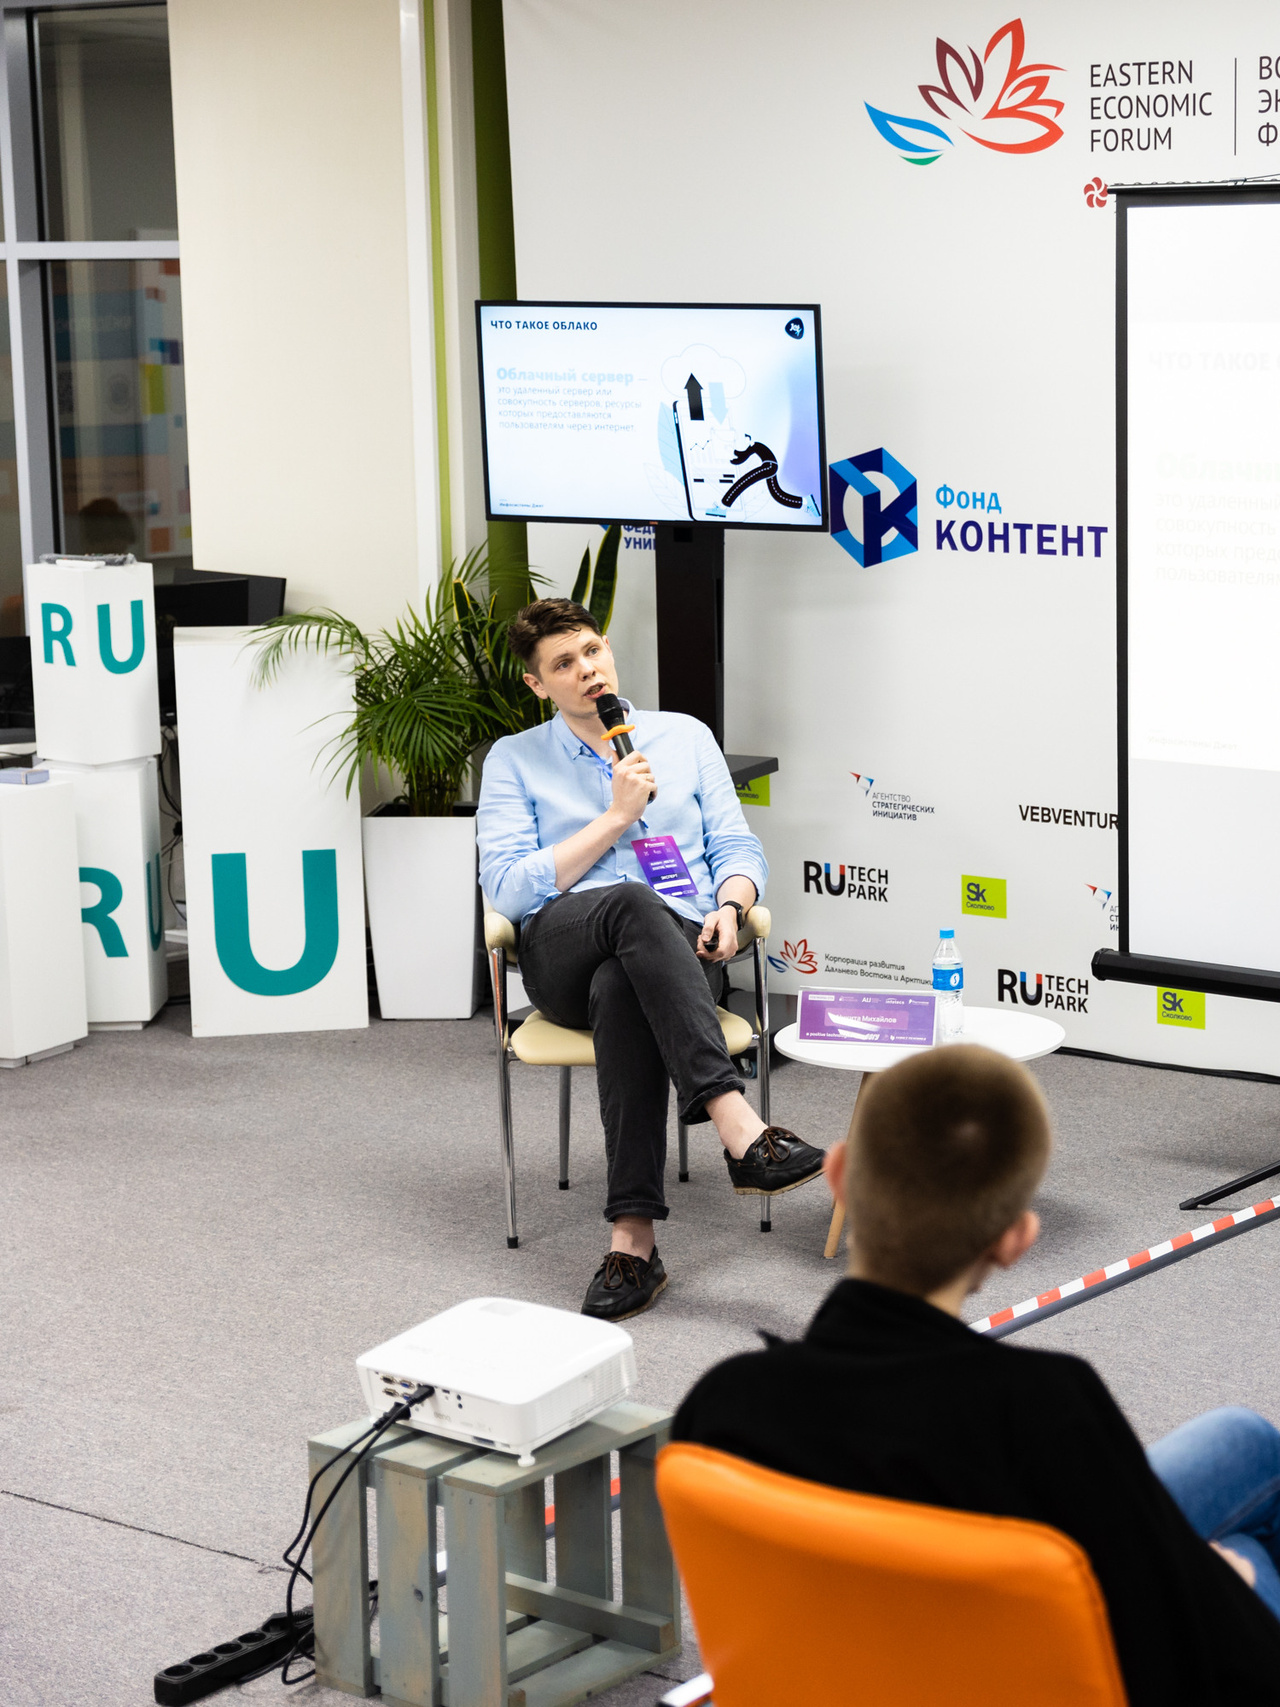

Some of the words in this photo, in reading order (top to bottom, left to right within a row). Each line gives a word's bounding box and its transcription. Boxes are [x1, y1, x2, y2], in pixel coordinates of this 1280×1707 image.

[1090, 60, 1194, 88] EASTERN
[1090, 92, 1213, 120] ECONOMIC
[1090, 127, 1172, 153] FORUM
[490, 320, 512, 330] ЧТО
[515, 320, 549, 330] ТАКОЕ
[552, 321, 598, 331] ОБЛАКО
[1147, 351, 1193, 372] ЧТО
[1200, 351, 1272, 372] ТАКОЕ
[496, 367, 577, 382] Облачный
[581, 372, 635, 386] сервер
[935, 484, 1002, 514] Фонд
[935, 519, 1109, 558] КОНТЕНТ
[871, 792, 912, 803] АГЕНТСТВО
[871, 801, 935, 814] СТРАТЕГИЧЕСКИХ
[872, 810, 918, 821] ИНИЦИАТИВ
[803, 860, 846, 896] RU
[847, 865, 889, 885] TECH
[847, 883, 889, 903] PARK
[966, 882, 987, 903] Sk
[965, 901, 995, 911] Сколково
[211, 848, 340, 997] U
[824, 953, 868, 967] Корпорация
[868, 958, 906, 972] развития
[824, 965, 859, 977] Дальнего
[859, 969, 892, 981] Востока
[997, 968, 1043, 1006] RU
[1045, 974, 1089, 995] TECH
[1044, 992, 1088, 1014] PARK
[1162, 991, 1184, 1013] Sk
[861, 1015, 897, 1024] Михайлов
[1161, 1011, 1193, 1021] Сколково
